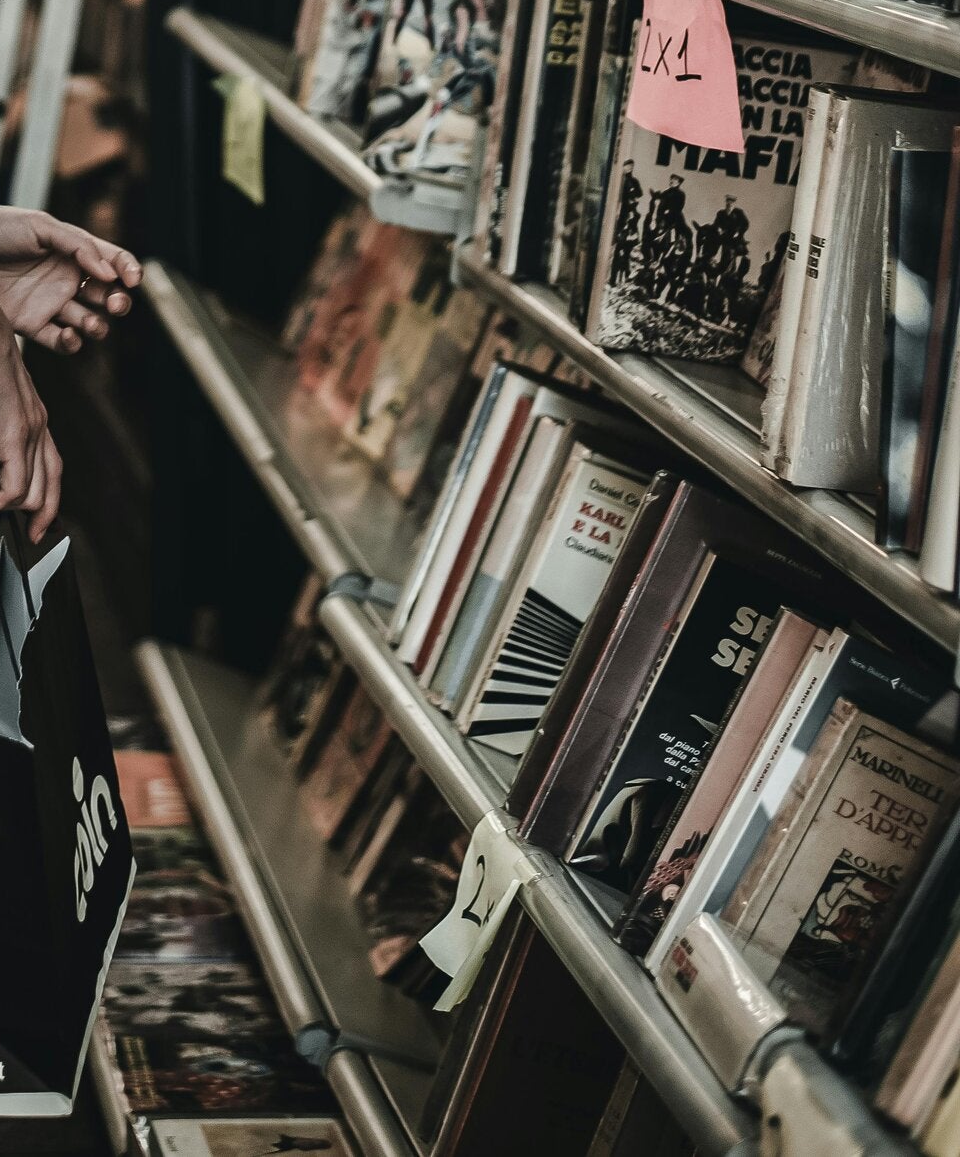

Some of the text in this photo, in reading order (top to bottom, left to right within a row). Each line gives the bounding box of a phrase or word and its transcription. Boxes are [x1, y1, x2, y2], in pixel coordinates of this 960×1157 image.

[771, 108, 804, 138] LA
[655, 132, 805, 187] MAFI
[580, 502, 627, 530] KARL
[571, 519, 611, 544] E LA
[801, 676, 818, 704] MARIO
[791, 705, 802, 720] DEL
[658, 732, 701, 756] dal piano
[665, 746, 688, 760] dalla
[663, 757, 680, 767] dal
[752, 762, 772, 792] OBAMA
